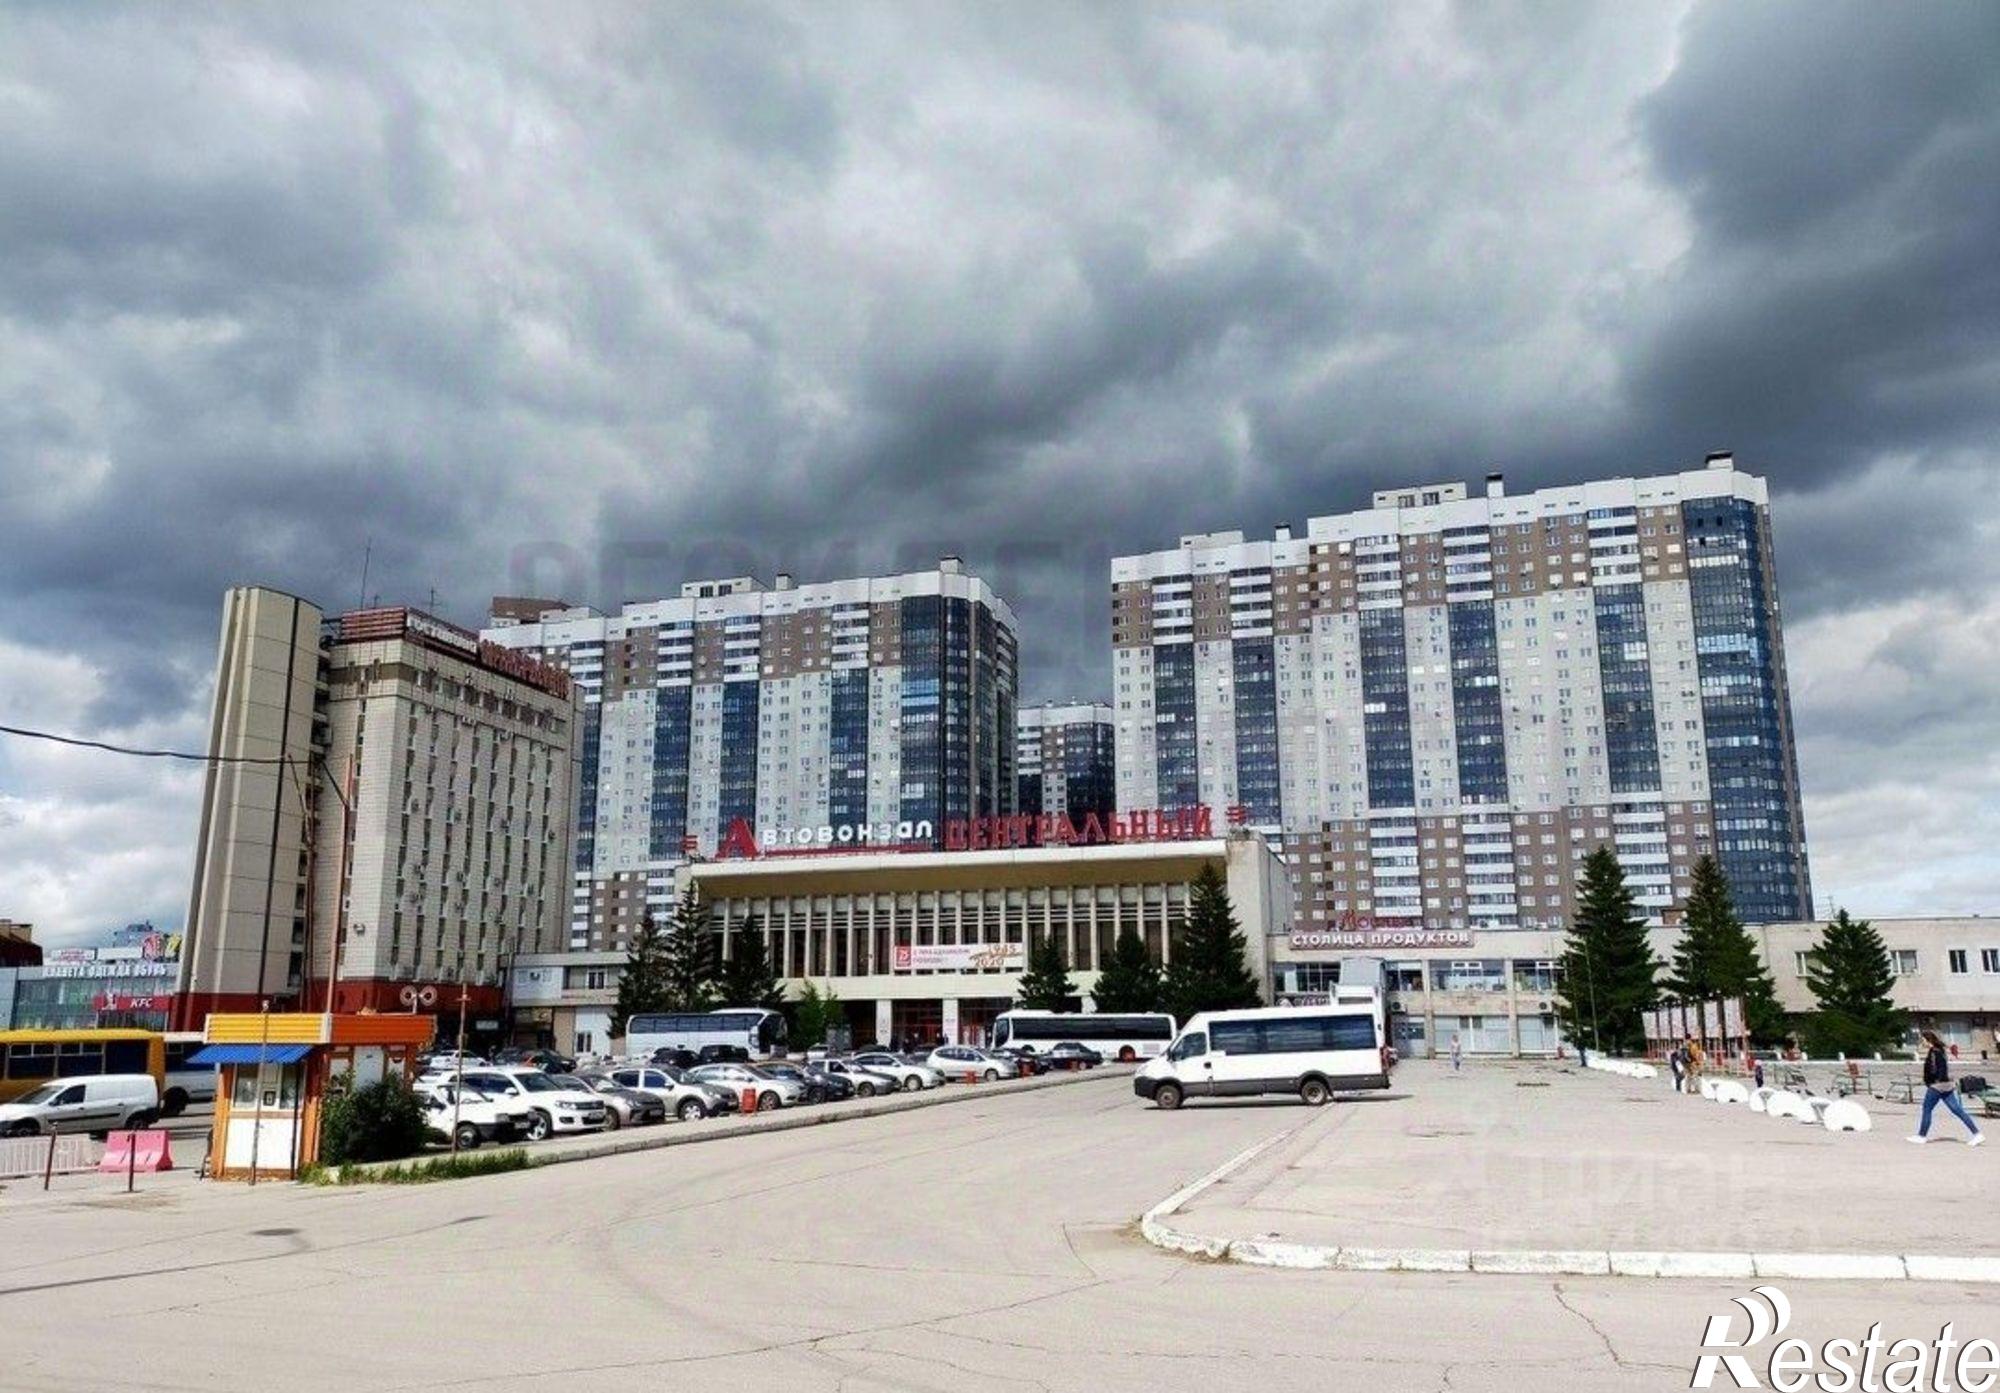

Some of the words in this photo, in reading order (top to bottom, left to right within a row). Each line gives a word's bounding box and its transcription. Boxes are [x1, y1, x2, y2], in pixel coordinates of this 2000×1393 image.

[944, 803, 1212, 850] ЦЕНТРАЛЬНЫЙ
[1292, 934, 1366, 946] СТОЛИЦА
[1371, 932, 1470, 945] ПРОДУКТОВ
[130, 998, 153, 1008] KFC
